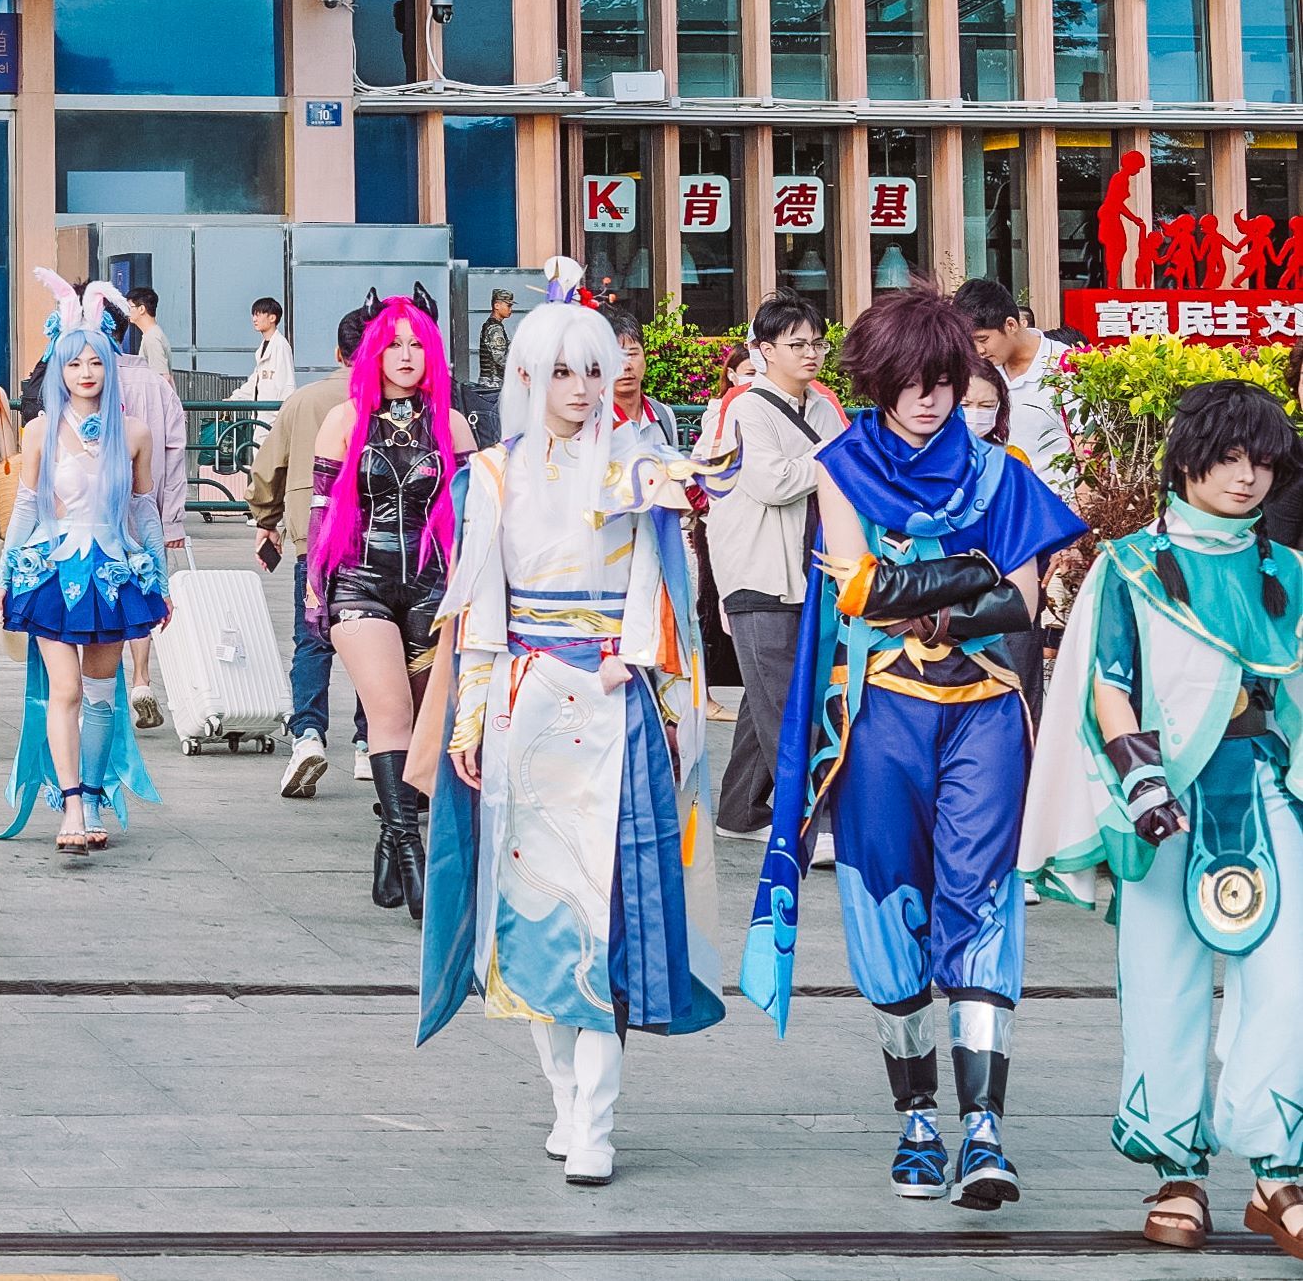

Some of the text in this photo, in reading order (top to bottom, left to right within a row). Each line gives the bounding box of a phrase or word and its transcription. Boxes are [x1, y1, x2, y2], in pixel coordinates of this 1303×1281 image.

[317, 109, 330, 121] 10
[1095, 299, 1303, 338] 富强 民主 文
